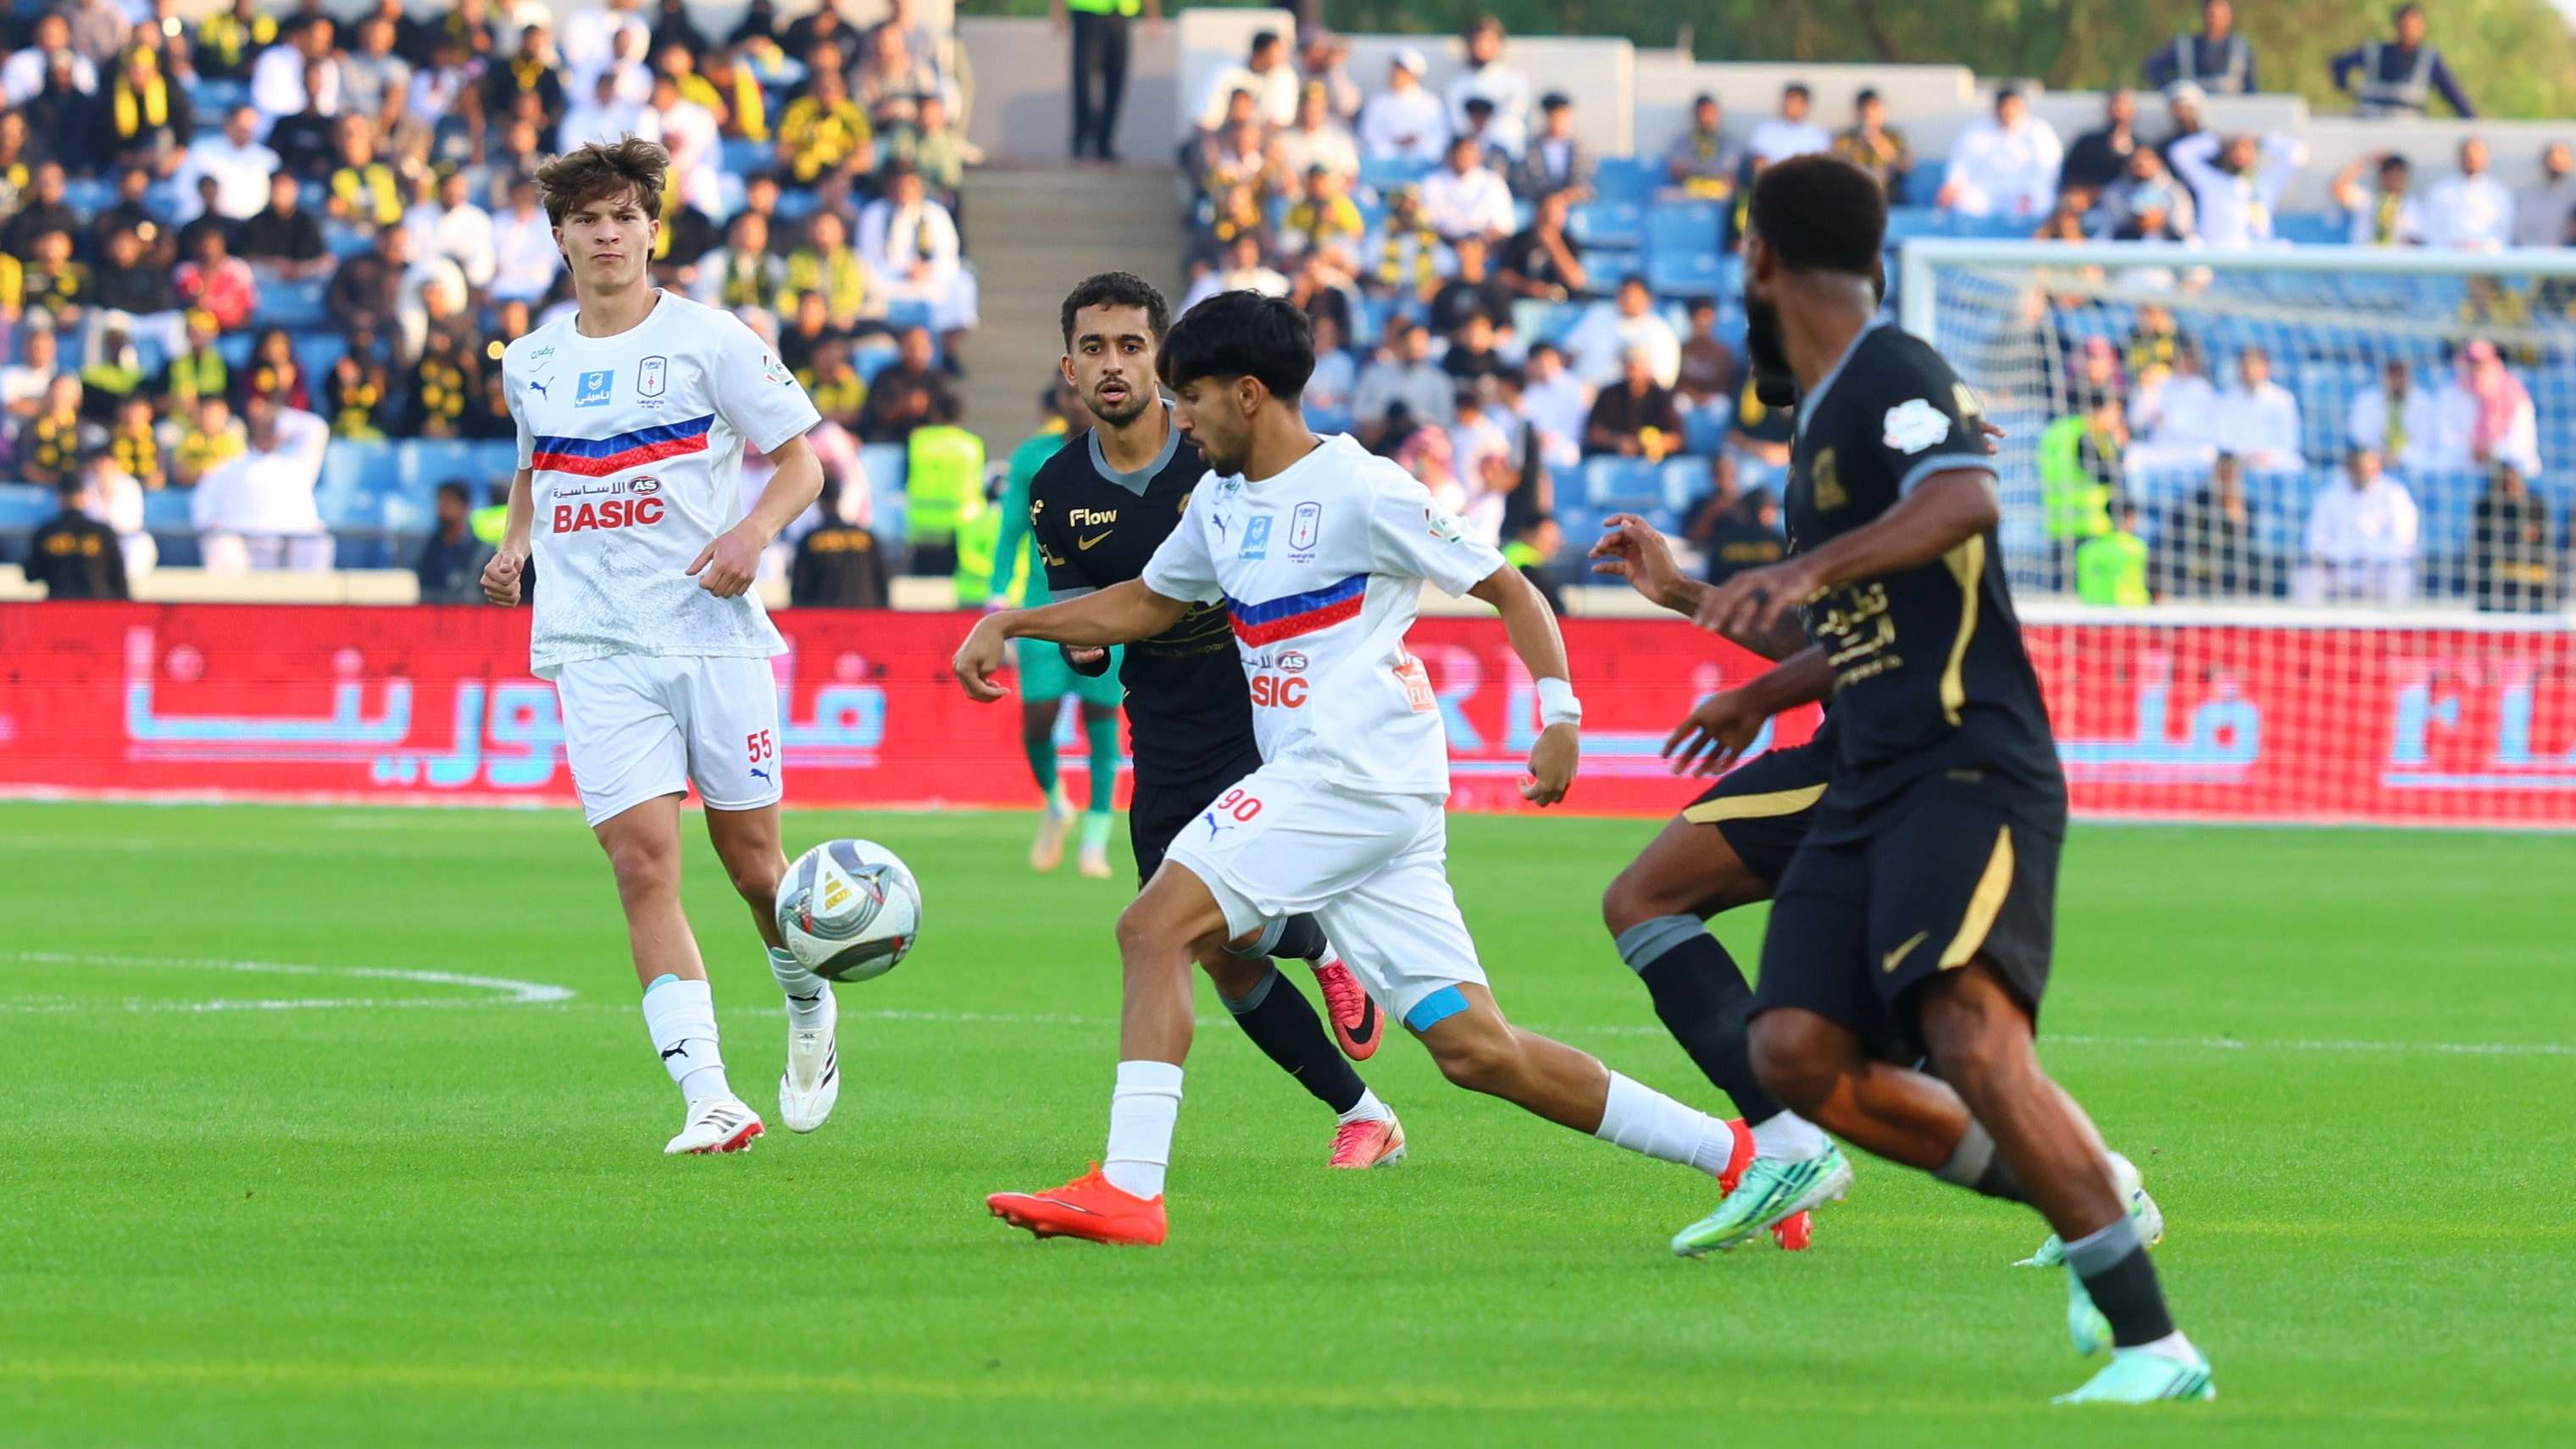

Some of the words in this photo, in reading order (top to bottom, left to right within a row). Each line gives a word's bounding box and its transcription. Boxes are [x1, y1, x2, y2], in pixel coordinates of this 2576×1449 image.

[633, 480, 658, 491] AS
[553, 497, 664, 533] BASIC
[1069, 508, 1118, 527] Flow
[1280, 656, 1306, 669] AS
[1251, 675, 1309, 708] SIC
[747, 729, 772, 763] 55
[1218, 789, 1263, 822] 90
